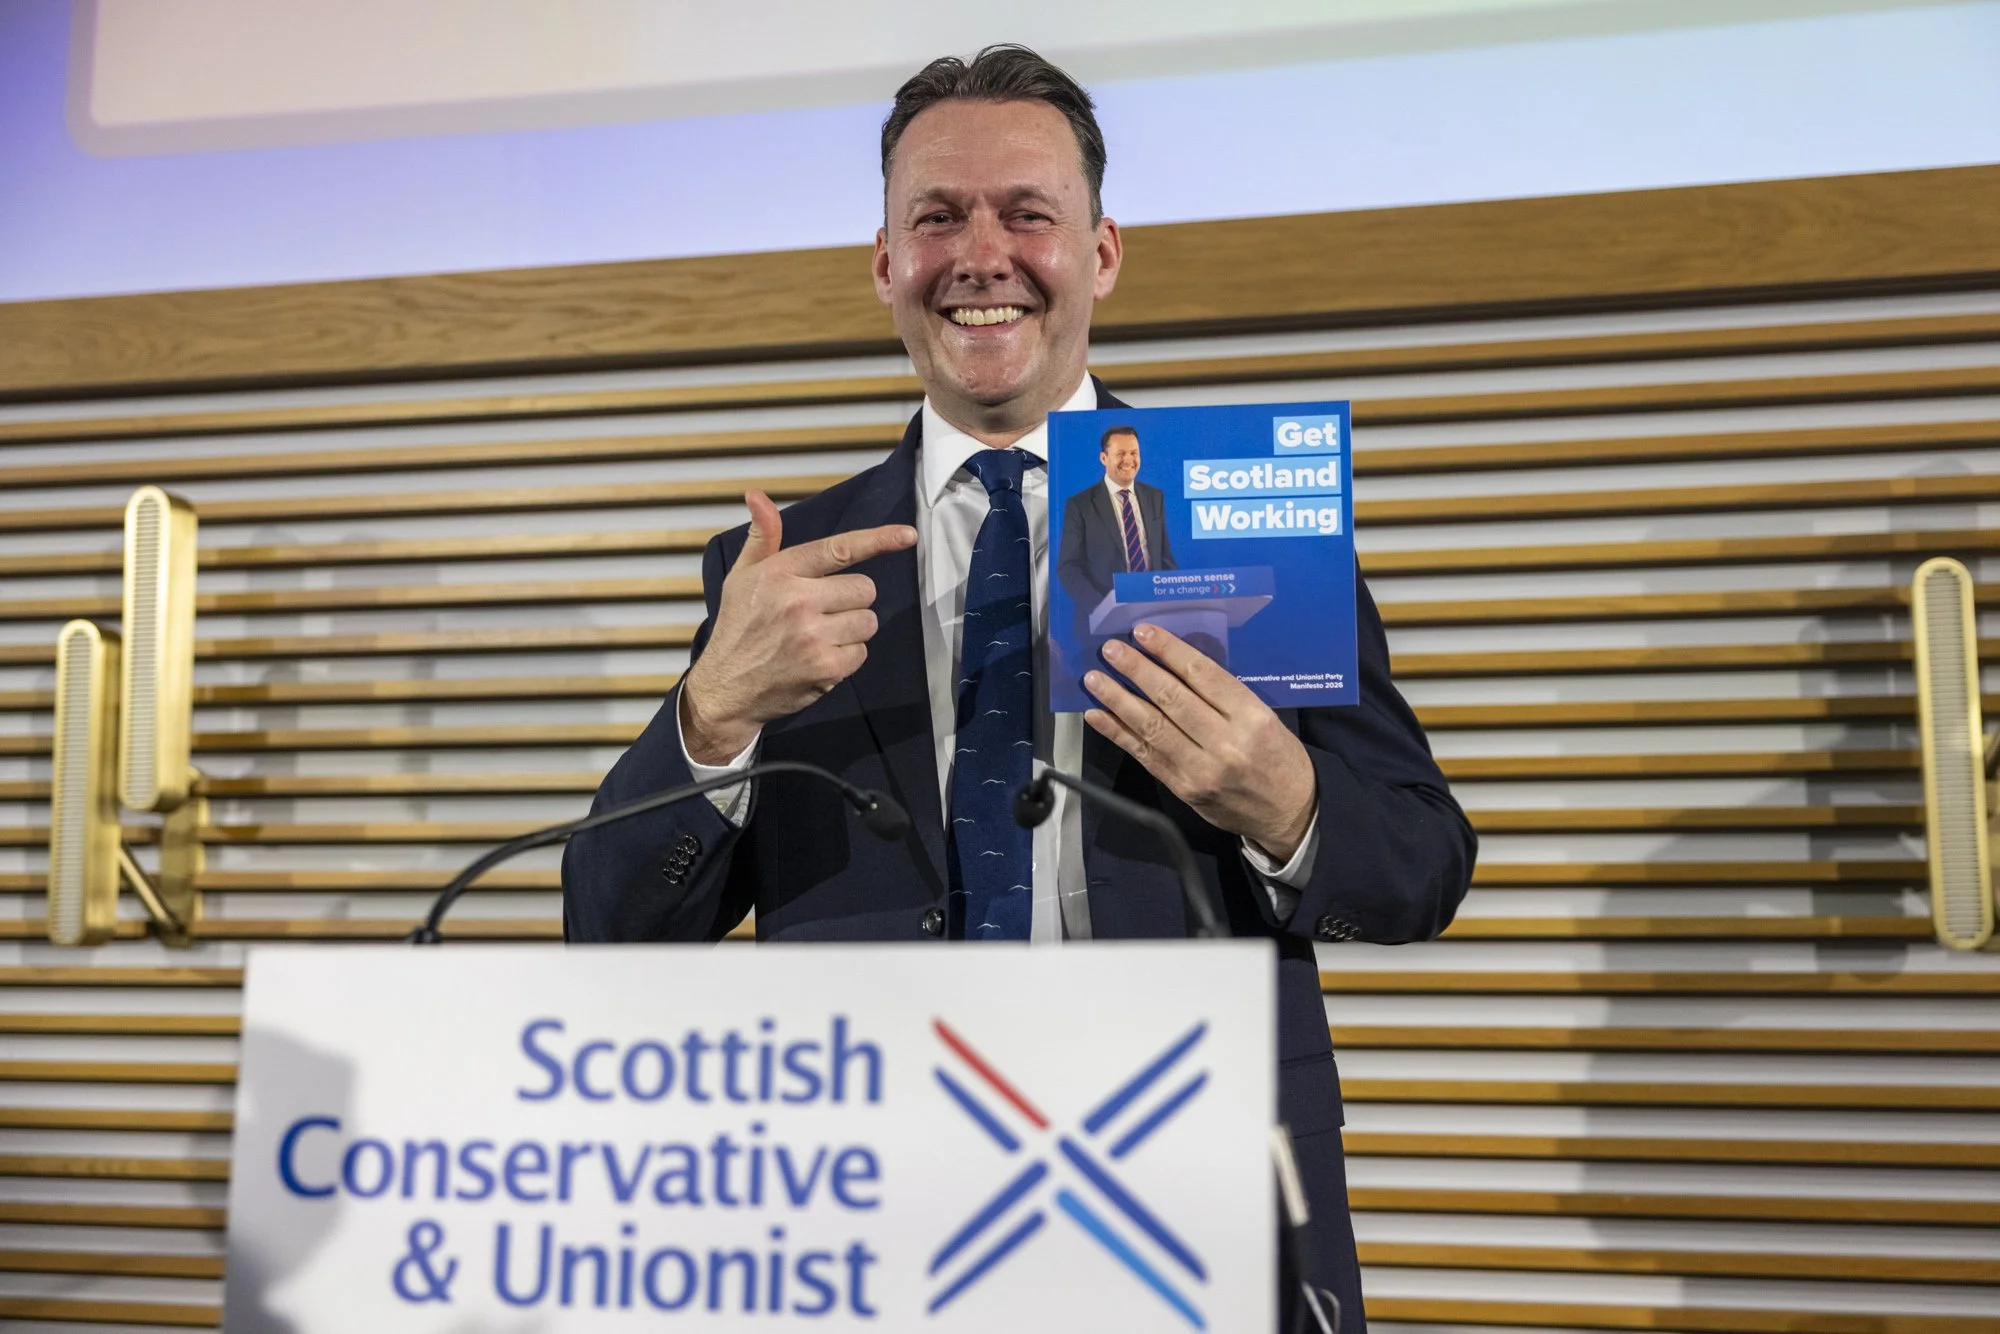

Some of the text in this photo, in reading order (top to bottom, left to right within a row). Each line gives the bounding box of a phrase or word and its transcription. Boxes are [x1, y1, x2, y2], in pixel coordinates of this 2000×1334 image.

[1277, 422, 1337, 447] Get
[1189, 461, 1337, 491] Scotland
[1196, 501, 1338, 534] Working
[1152, 573, 1235, 584] Common sense
[1153, 587, 1167, 595] for
[1177, 585, 1211, 596] change
[1236, 674, 1281, 682] Conservative
[1295, 673, 1324, 681] Unionist
[1325, 673, 1344, 682] Party
[1290, 681, 1344, 690] Manifesto 2026
[515, 1015, 884, 1105] Scottish
[276, 1115, 883, 1210] Conservative
[391, 1218, 879, 1318] & Unionist
